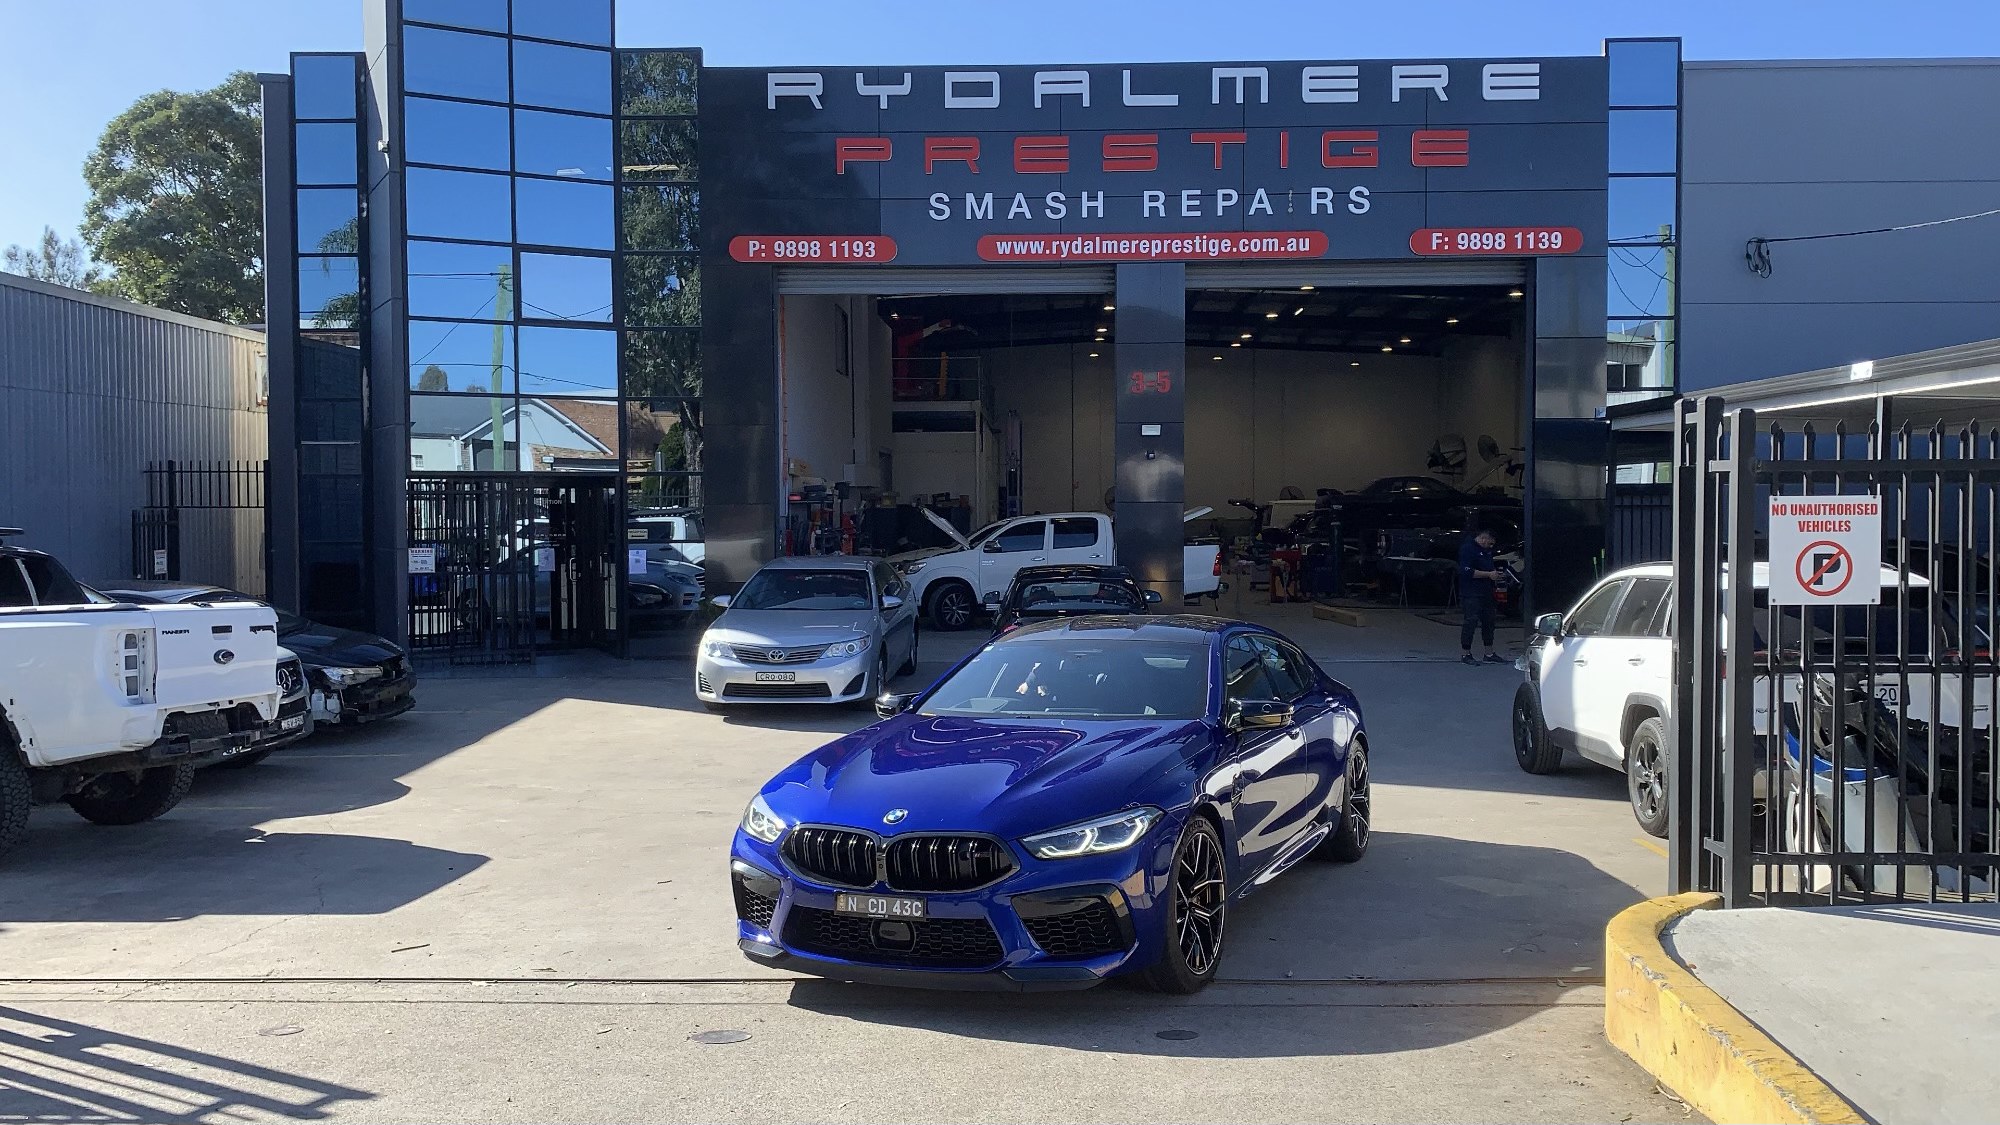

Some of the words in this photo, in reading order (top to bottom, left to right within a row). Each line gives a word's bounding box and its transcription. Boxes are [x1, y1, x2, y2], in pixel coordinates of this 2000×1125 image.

[767, 63, 1540, 109] RYDALMERE
[836, 131, 1469, 174] PRESTIGE
[928, 190, 1104, 221] SMASH
[1143, 185, 1371, 218] REPARS
[748, 240, 767, 258] P:
[774, 240, 821, 259] 9898
[829, 239, 876, 258] 1193
[995, 236, 1311, 259] www.rydalmereprestige.com.au
[1431, 232, 1449, 250] F:
[1457, 232, 1506, 250] 9898
[1513, 231, 1562, 249] 1139
[1131, 371, 1171, 393] 3-5
[1772, 504, 1787, 516] NO
[1791, 503, 1878, 516] UNAUTHORISED
[1798, 520, 1851, 533] VEHICLES
